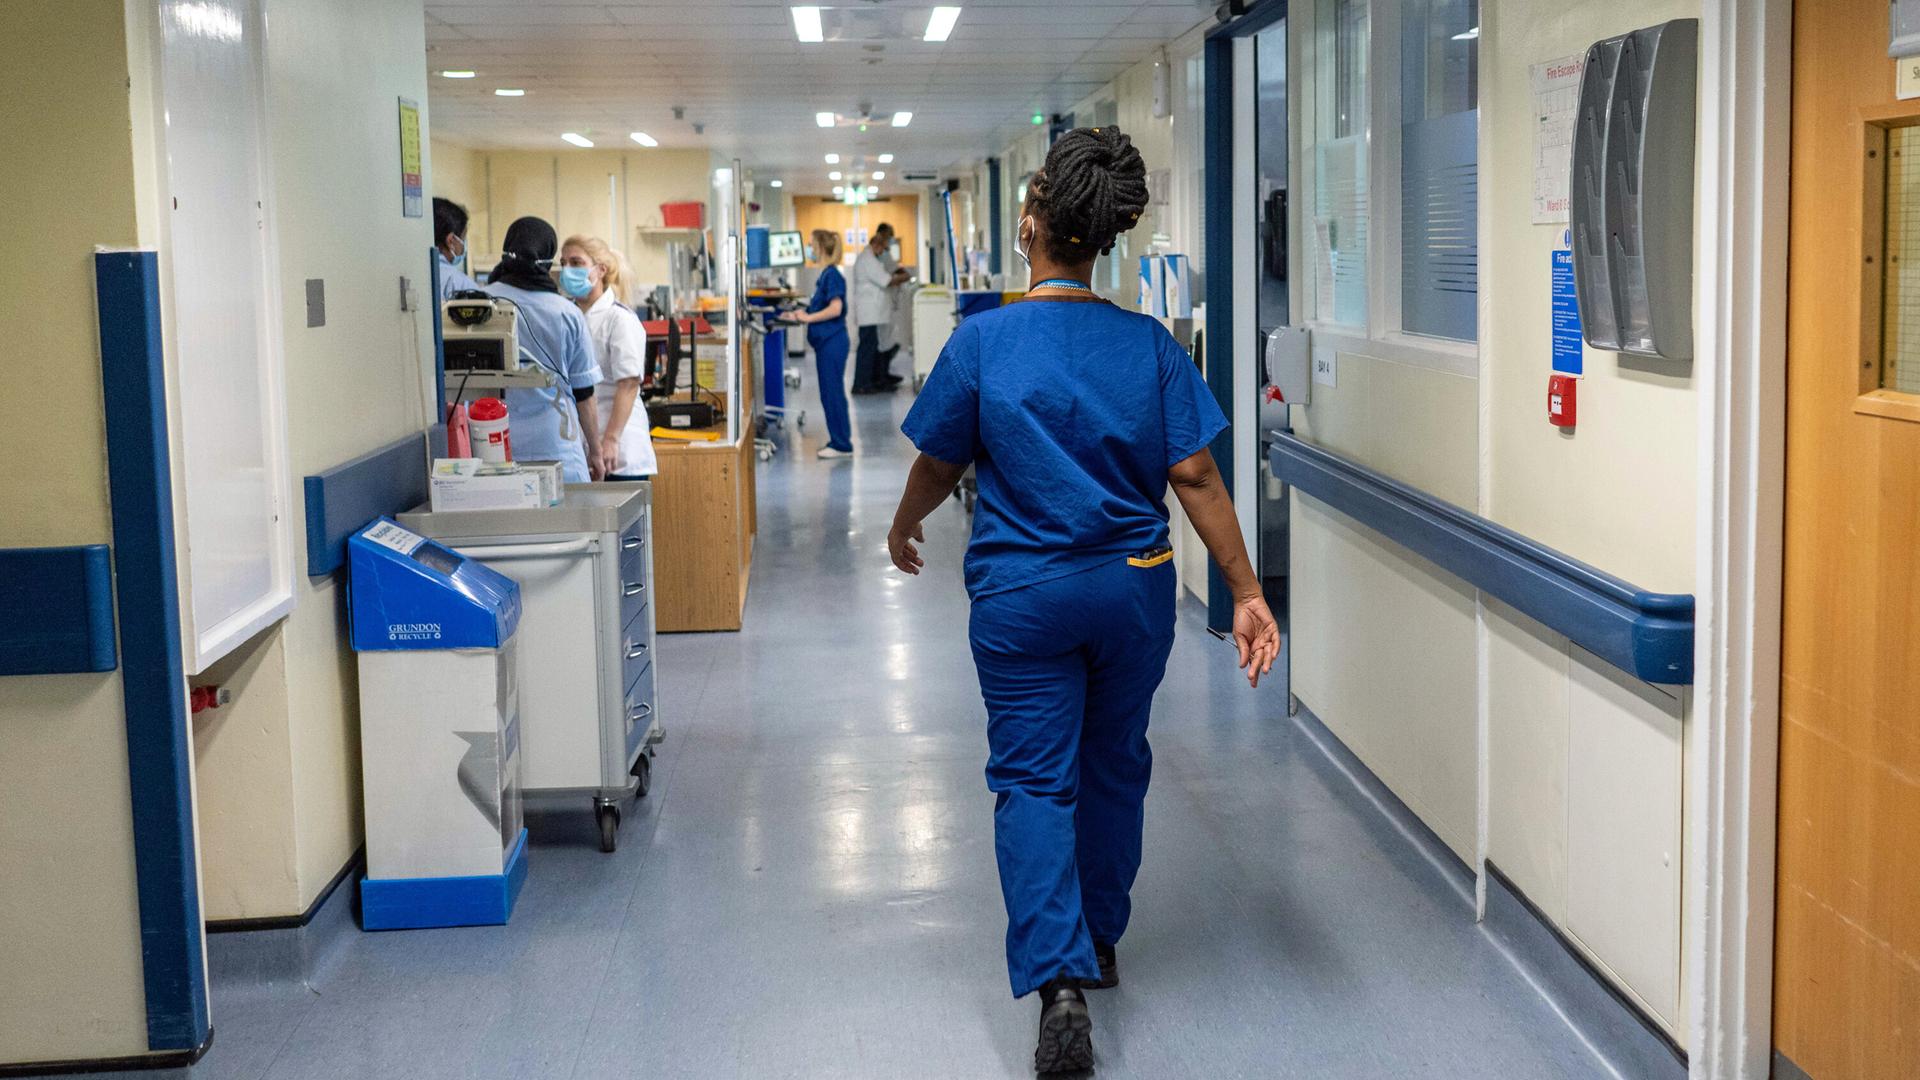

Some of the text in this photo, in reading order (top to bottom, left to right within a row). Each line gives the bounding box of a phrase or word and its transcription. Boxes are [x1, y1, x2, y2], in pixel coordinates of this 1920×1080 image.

[1546, 67, 1557, 80] Fire
[1558, 64, 1575, 78] Escape
[388, 623, 441, 632] GRUNDON
